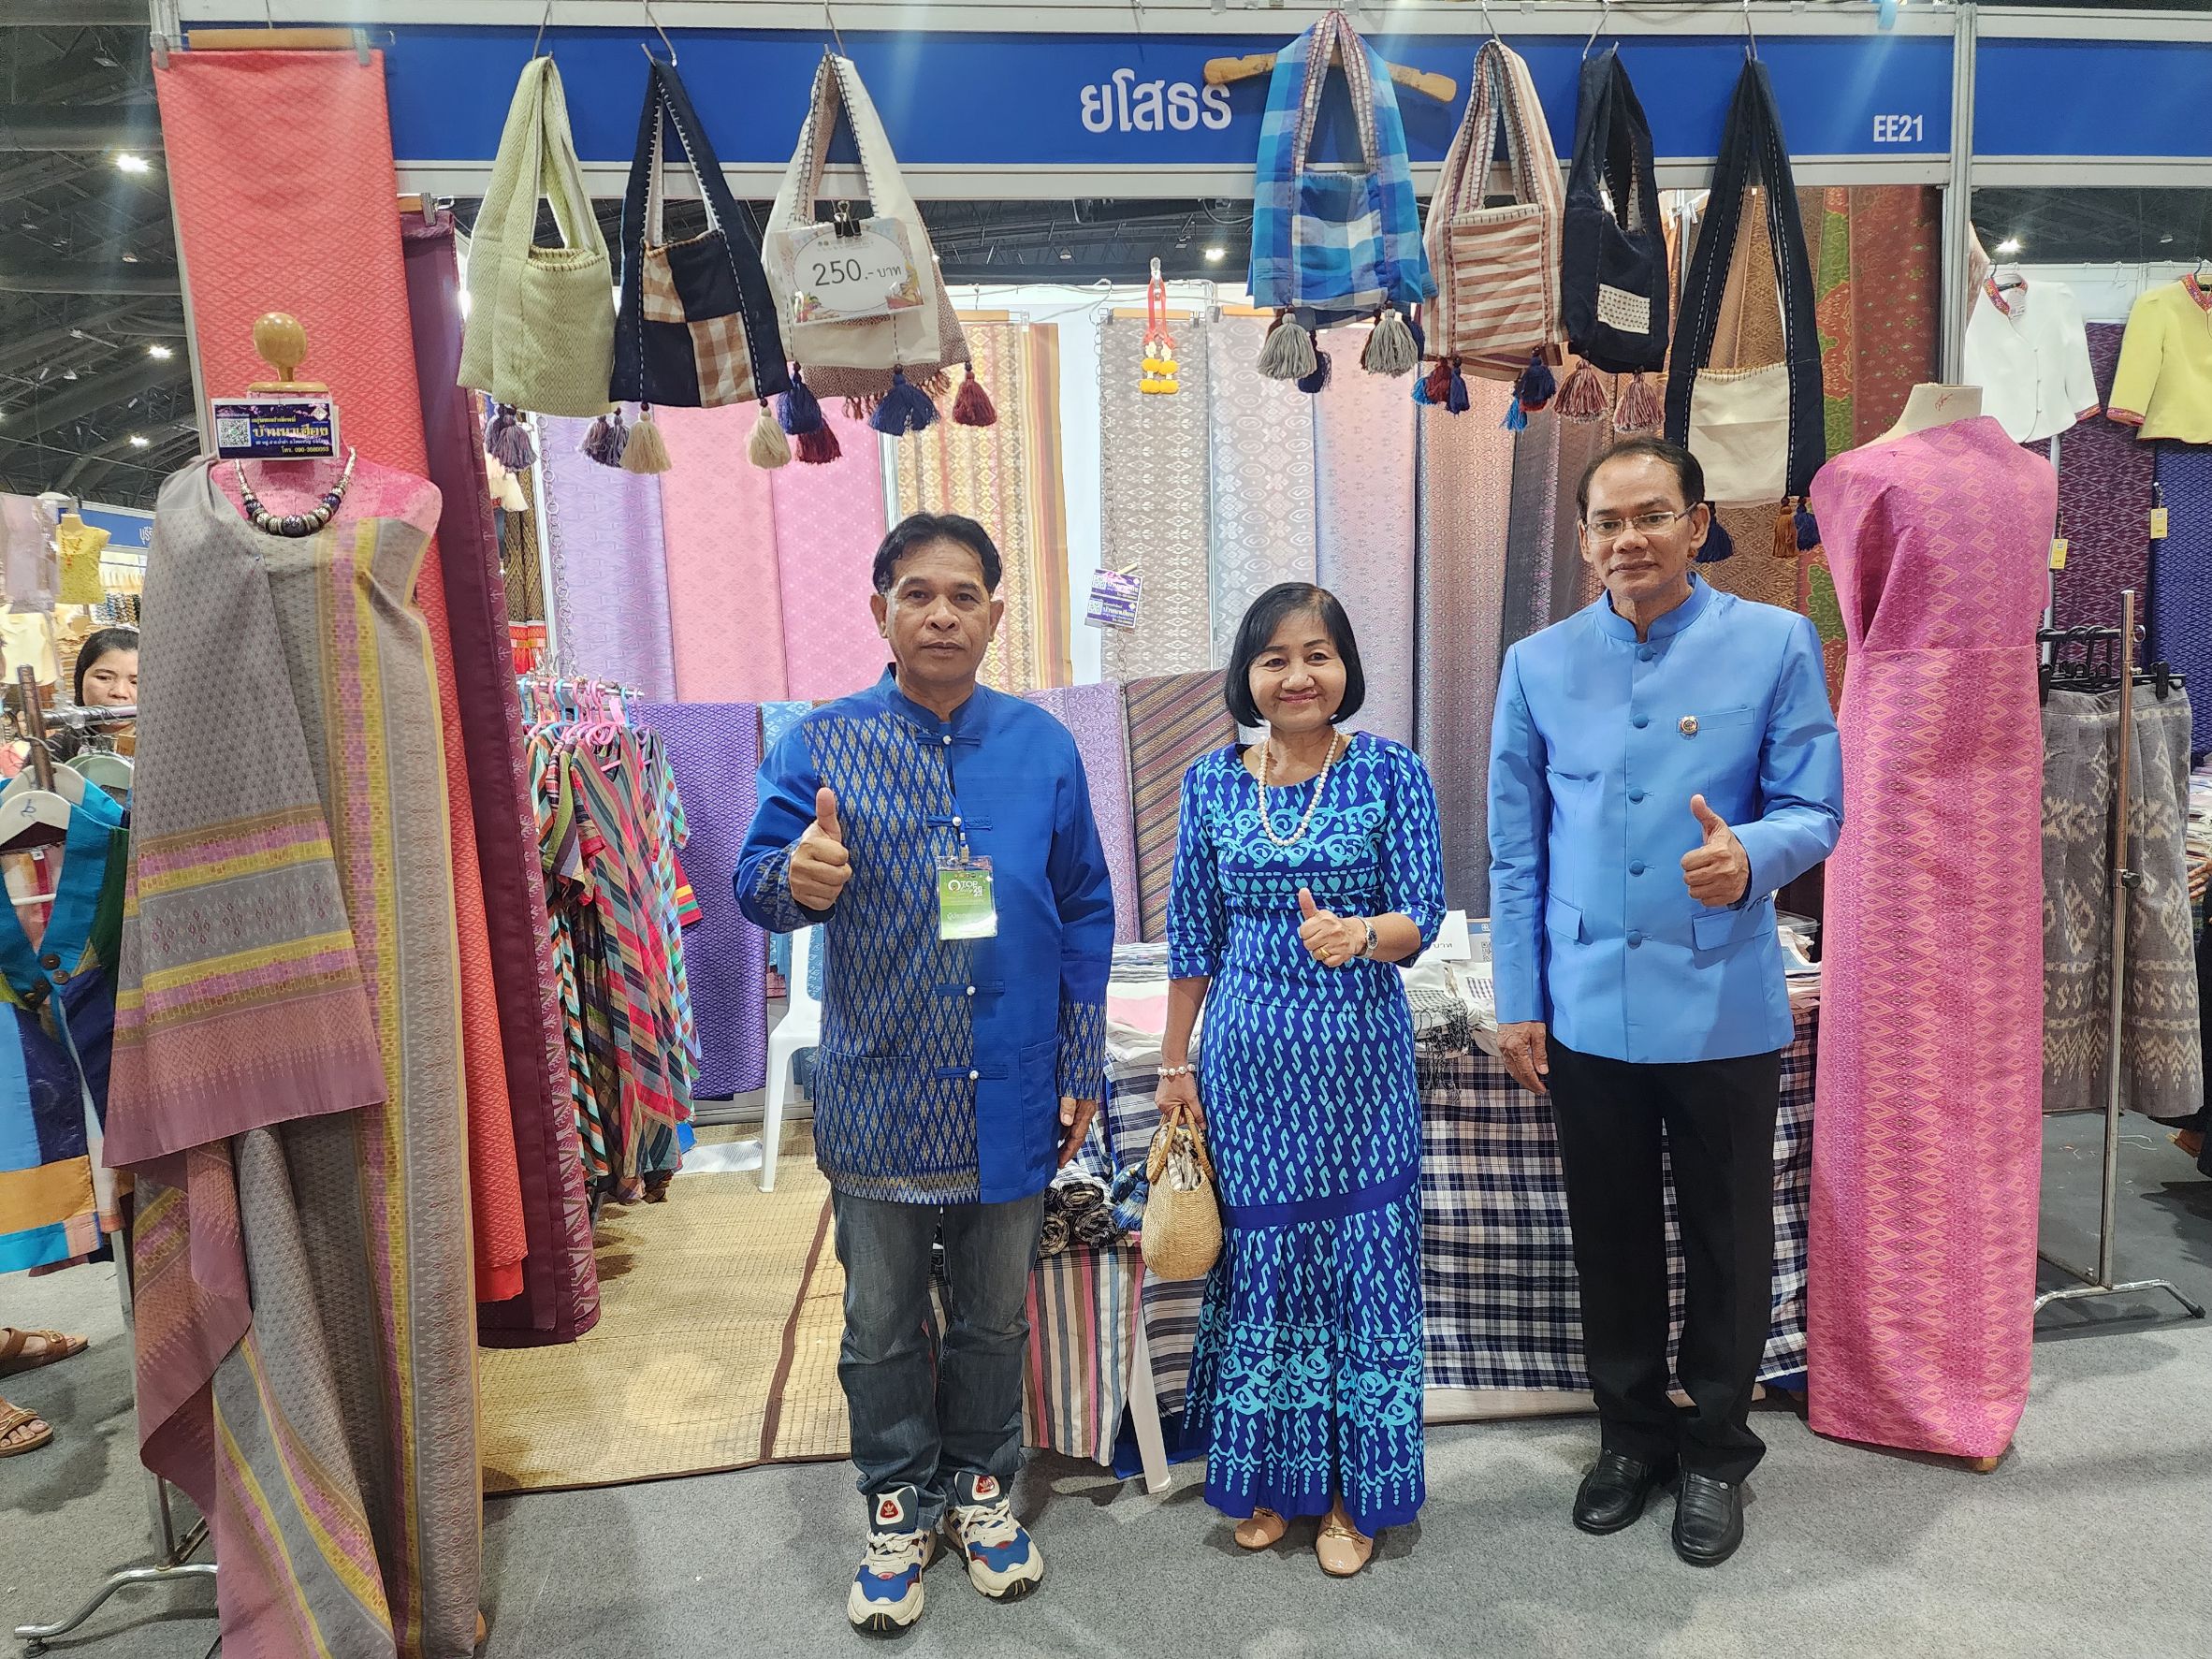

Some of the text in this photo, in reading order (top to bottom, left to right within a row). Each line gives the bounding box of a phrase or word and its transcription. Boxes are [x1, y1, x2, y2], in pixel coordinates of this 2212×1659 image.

[1081, 68, 1231, 133] ยโสธร
[1873, 114, 1923, 142] EE21
[812, 258, 902, 286] 250.- บาท
